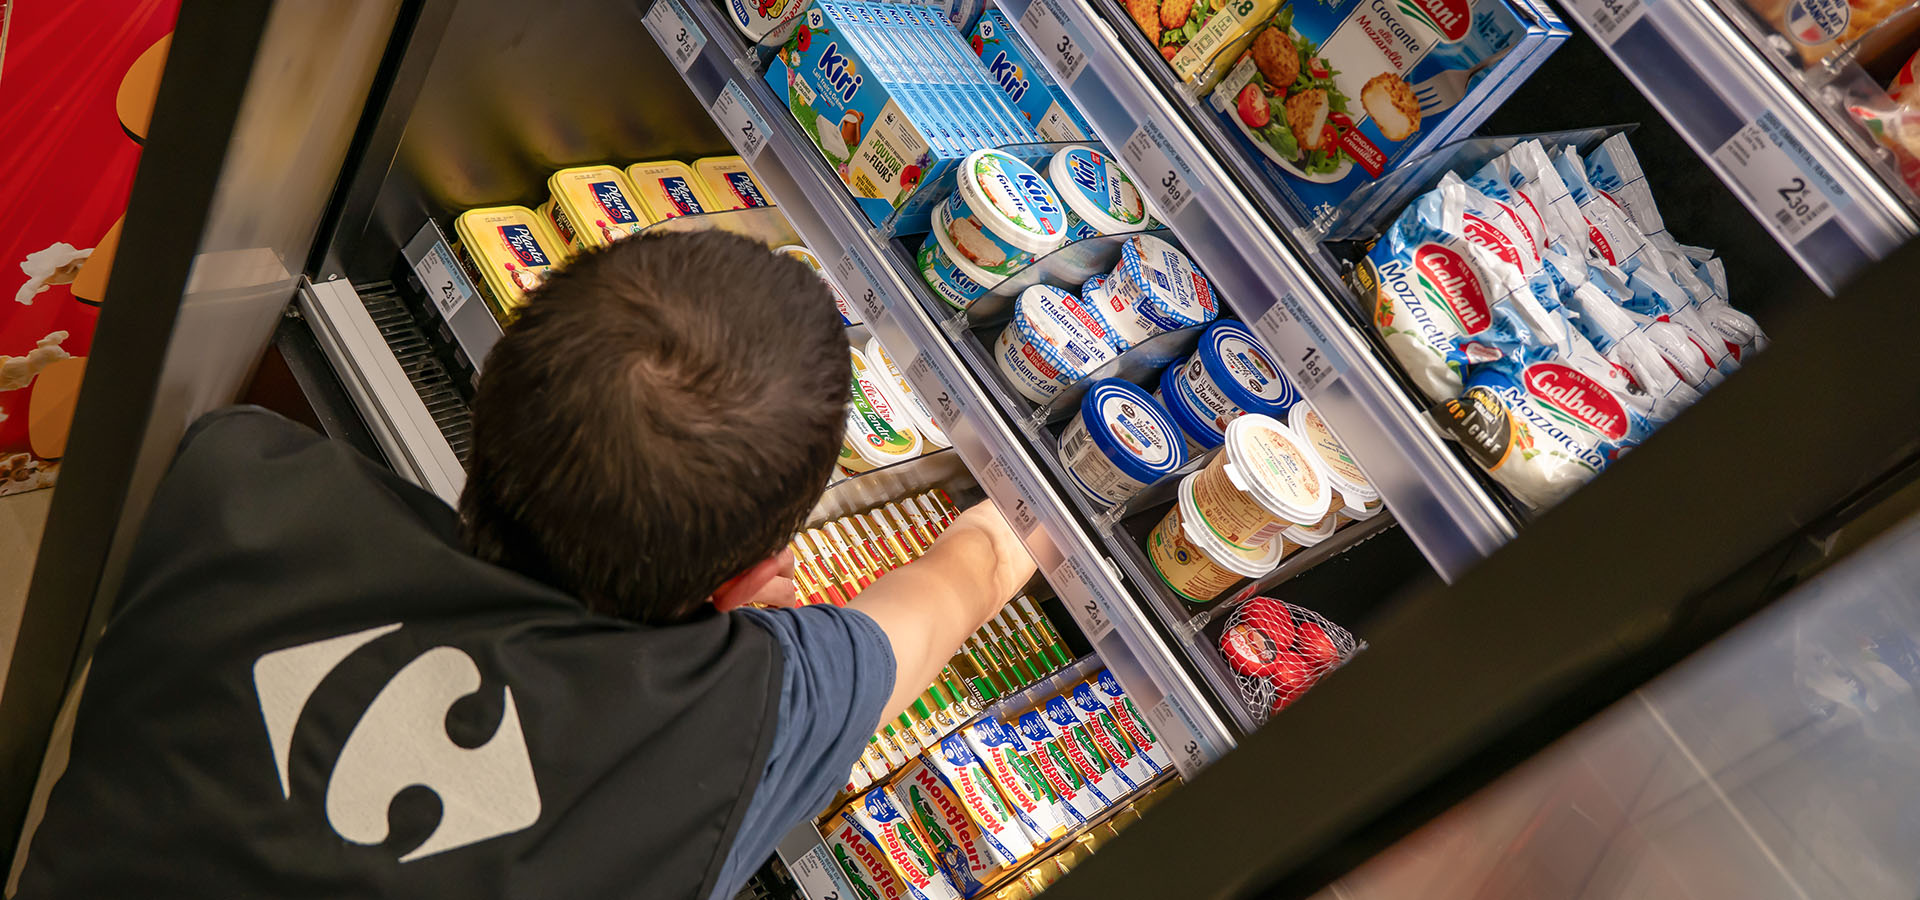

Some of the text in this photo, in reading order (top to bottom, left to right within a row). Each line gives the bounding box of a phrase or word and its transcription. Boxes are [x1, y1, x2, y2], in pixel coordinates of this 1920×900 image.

[1356, 15, 1403, 70] Mozzarella
[1371, 0, 1420, 53] Croccante
[1378, 28, 1393, 45] alla
[819, 42, 862, 102] Kiri
[991, 52, 1028, 103] Kiri
[872, 139, 901, 174] POUVOIR
[1344, 136, 1381, 171] croustillant
[1350, 131, 1378, 157] FONDANT
[868, 152, 894, 183] FLEURS
[1071, 154, 1098, 193] Kiri
[599, 193, 612, 209] Fin
[604, 184, 631, 221] Planta
[669, 187, 680, 202] Fin
[673, 179, 700, 214] Planta
[733, 182, 744, 196] Fin
[737, 174, 763, 207] Planta
[996, 174, 1026, 213] fouetté
[1018, 173, 1058, 214] Kiri
[1109, 176, 1122, 207] fouetté
[509, 237, 522, 252] Fin
[514, 227, 544, 264] Planta
[938, 281, 967, 306] fouetté
[950, 266, 980, 294] Kiri
[1424, 253, 1484, 328] Galbani
[1037, 294, 1085, 339] Madame
[1294, 305, 1328, 343] MOZZARELLA
[1381, 262, 1454, 352] Mozzarella
[1007, 344, 1038, 378] Madame
[1194, 384, 1226, 416] Fouetté
[1201, 378, 1226, 404] LE FROMAGE
[1532, 370, 1619, 433] Galbani
[864, 410, 894, 442] Tendre
[1467, 424, 1502, 454] CHEF
[1504, 386, 1604, 469] Mozzarella
[965, 678, 987, 707] BEURRE
[1085, 712, 1128, 769] Montfleuri
[1110, 696, 1153, 752] Montfleuri
[921, 757, 941, 776] DOUX
[1032, 741, 1078, 801] Montfleuri
[1058, 725, 1102, 784] Montfleuri
[988, 746, 1037, 814] Montfleuri
[954, 766, 1005, 834] Montfleuri
[846, 815, 865, 833] DOUX
[916, 768, 986, 871] Montfleuri
[840, 827, 900, 900] Montfle
[879, 823, 930, 889] Montfleuri
